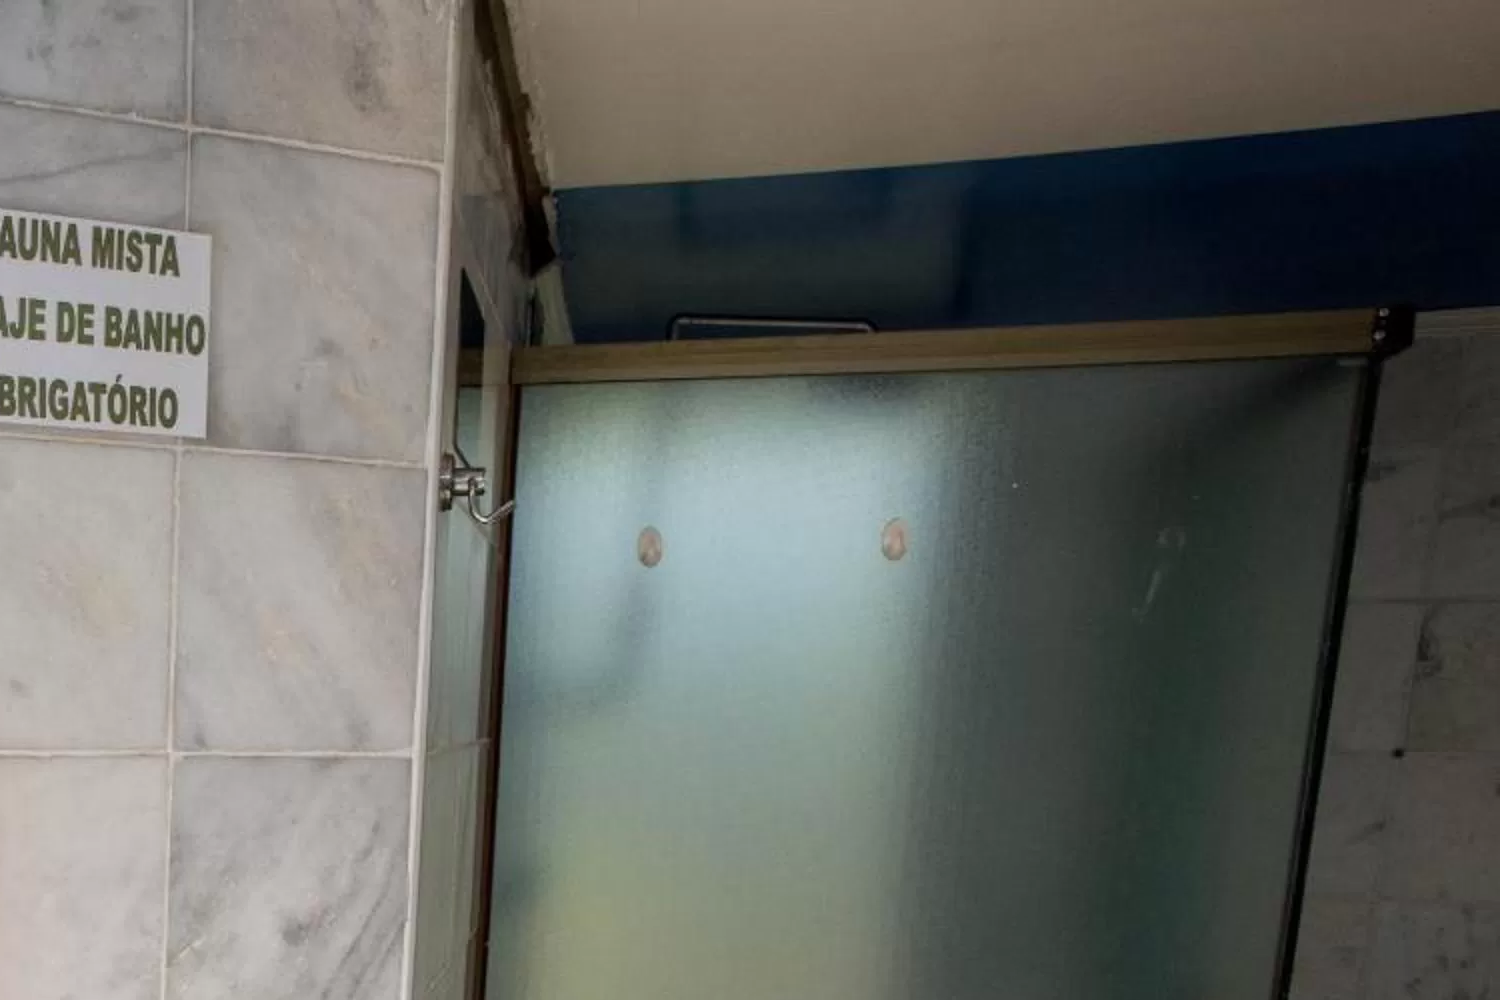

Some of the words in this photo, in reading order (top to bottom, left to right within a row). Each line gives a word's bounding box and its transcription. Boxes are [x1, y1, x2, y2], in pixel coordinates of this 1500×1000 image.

[91, 225, 181, 278] MISTA
[56, 301, 96, 346] DE
[104, 305, 206, 356] BANHO
